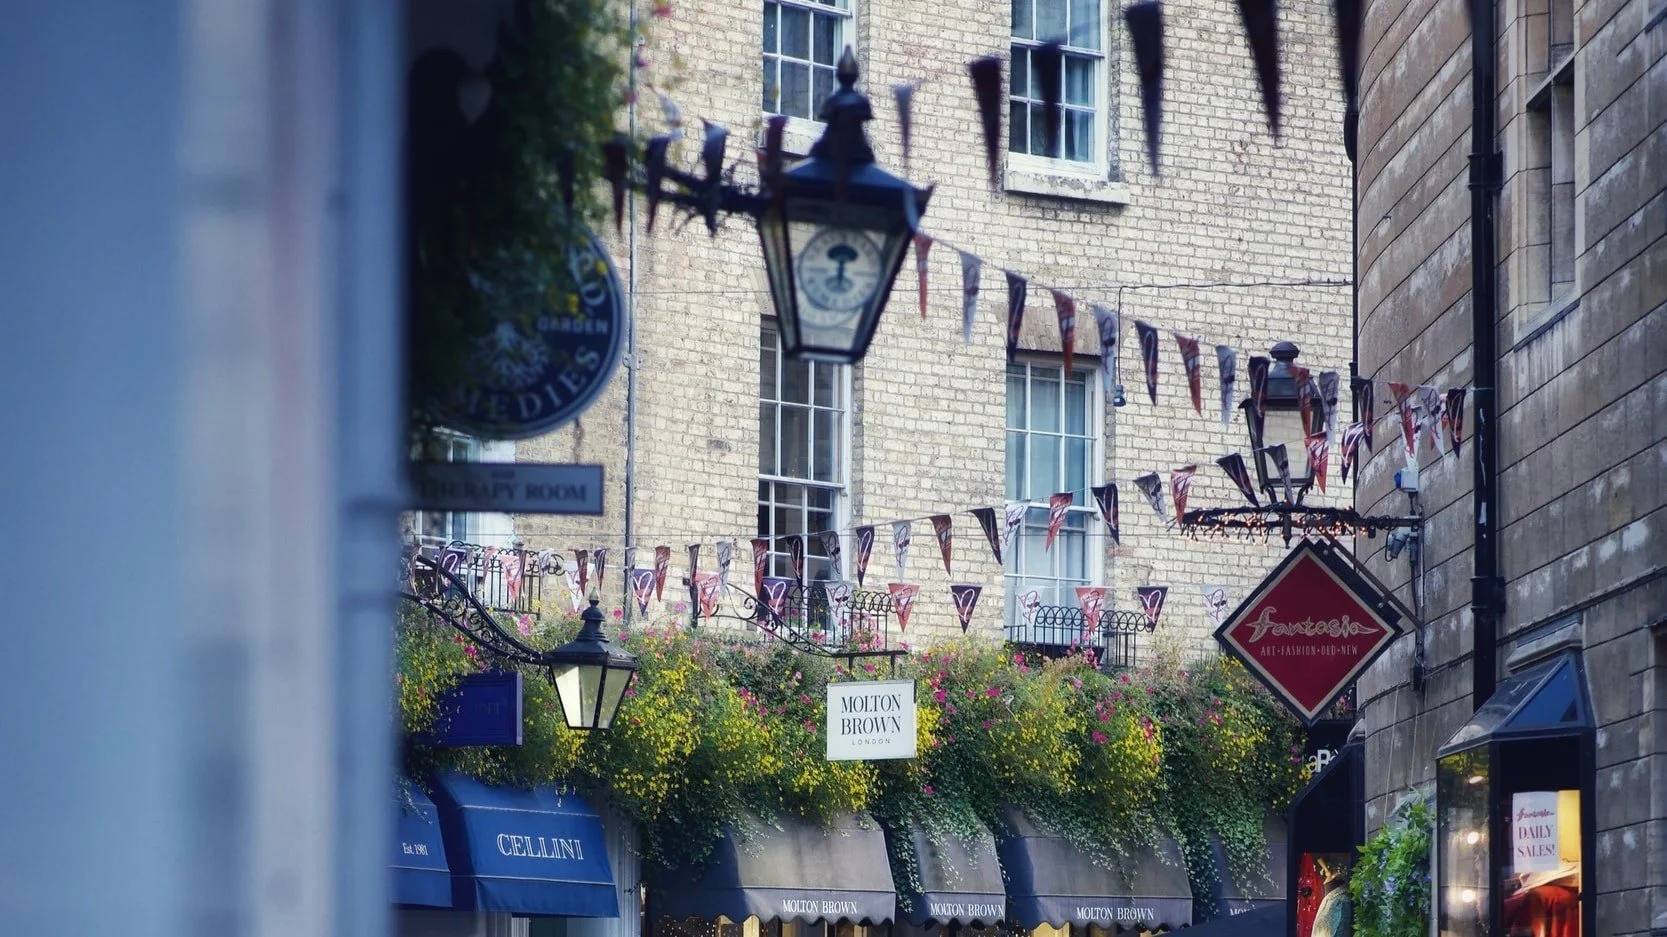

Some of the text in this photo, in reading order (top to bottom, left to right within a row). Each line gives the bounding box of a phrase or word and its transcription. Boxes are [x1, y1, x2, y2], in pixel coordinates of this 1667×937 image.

[525, 483, 588, 502] ROOM
[841, 694, 901, 714] MOLTON
[841, 716, 901, 736] BROWN
[851, 738, 890, 746] LONDON
[1518, 824, 1553, 840] DAILY
[497, 833, 584, 860] CELLINI
[1517, 843, 1556, 857] SALES!
[782, 899, 858, 915] MOLTON BROWN
[930, 903, 1005, 918] MOLTON BROWN
[1076, 906, 1154, 921] MOLTON BROWN
